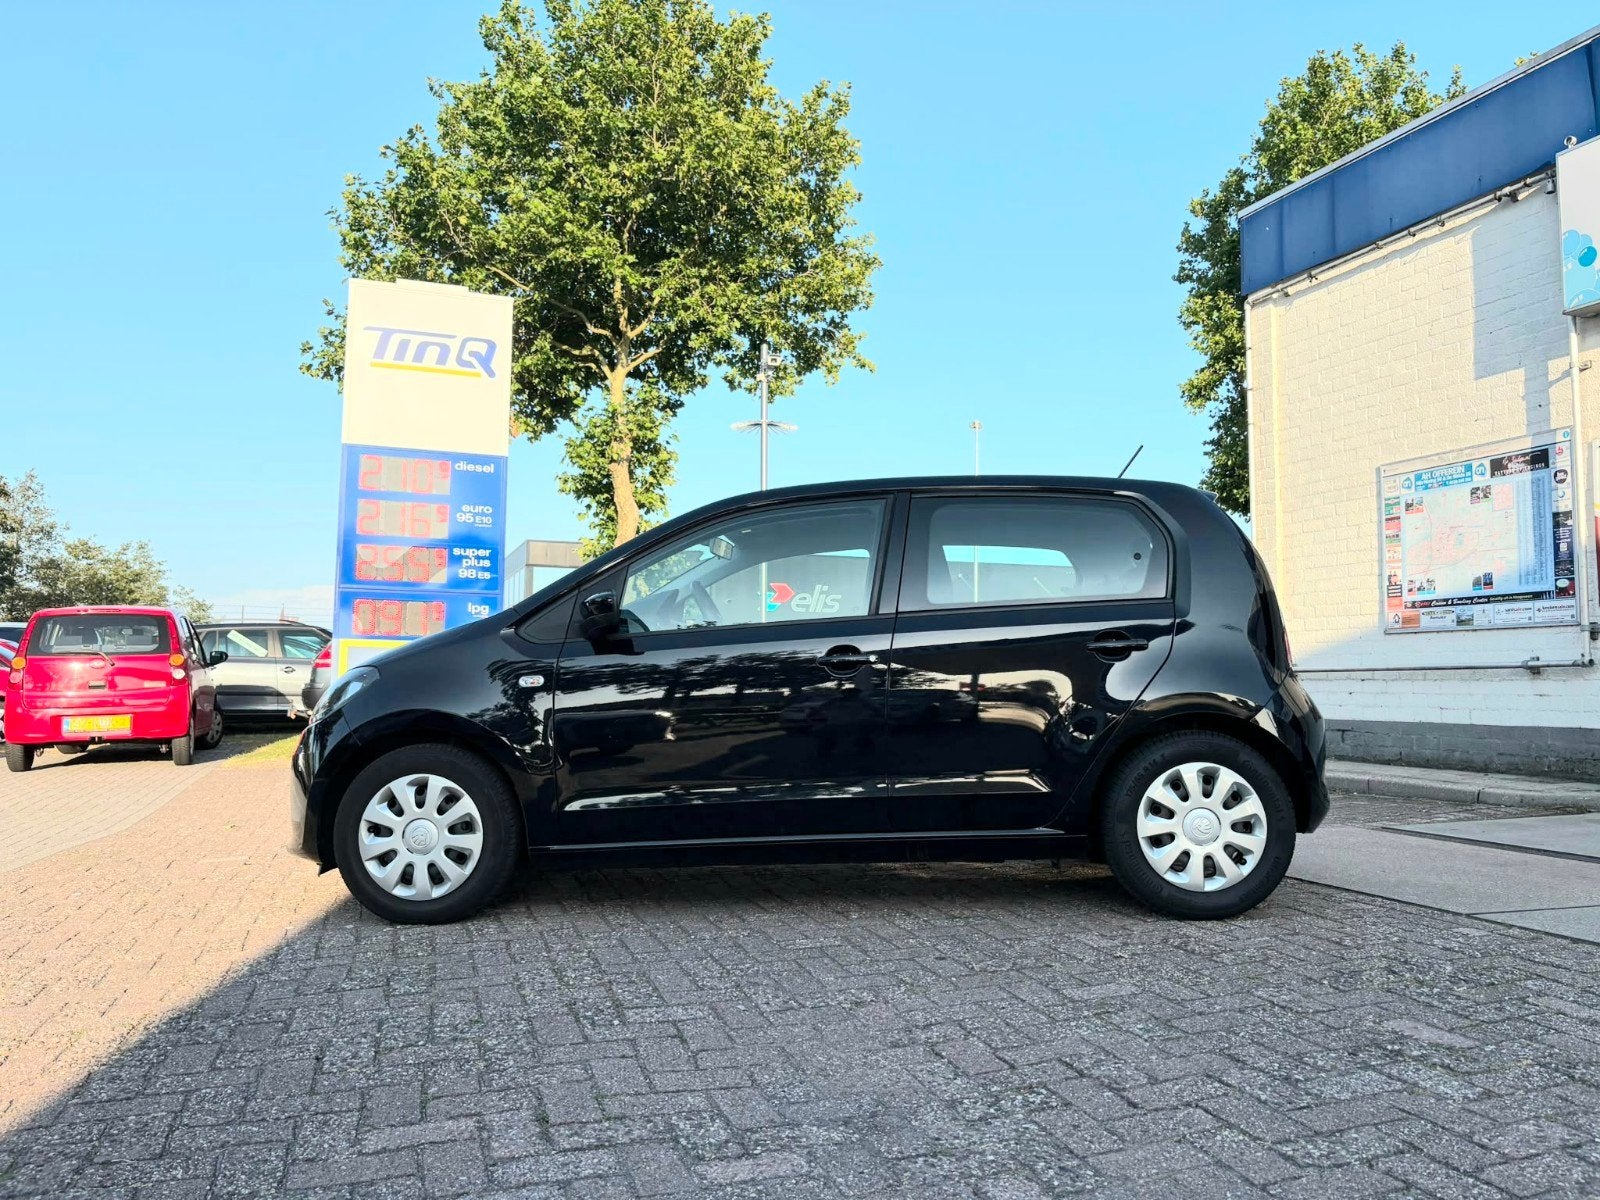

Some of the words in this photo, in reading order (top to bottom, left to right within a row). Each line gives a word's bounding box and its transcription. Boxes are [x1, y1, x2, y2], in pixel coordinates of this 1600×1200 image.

[454, 461, 495, 474] diesel
[462, 504, 493, 514] euro
[456, 512, 474, 523] 95
[475, 515, 493, 525] E10
[452, 547, 492, 558] super
[462, 557, 491, 568] plus
[458, 568, 476, 579] 98
[477, 571, 491, 579] E5
[790, 584, 842, 613] elis
[467, 602, 490, 615] lpg
